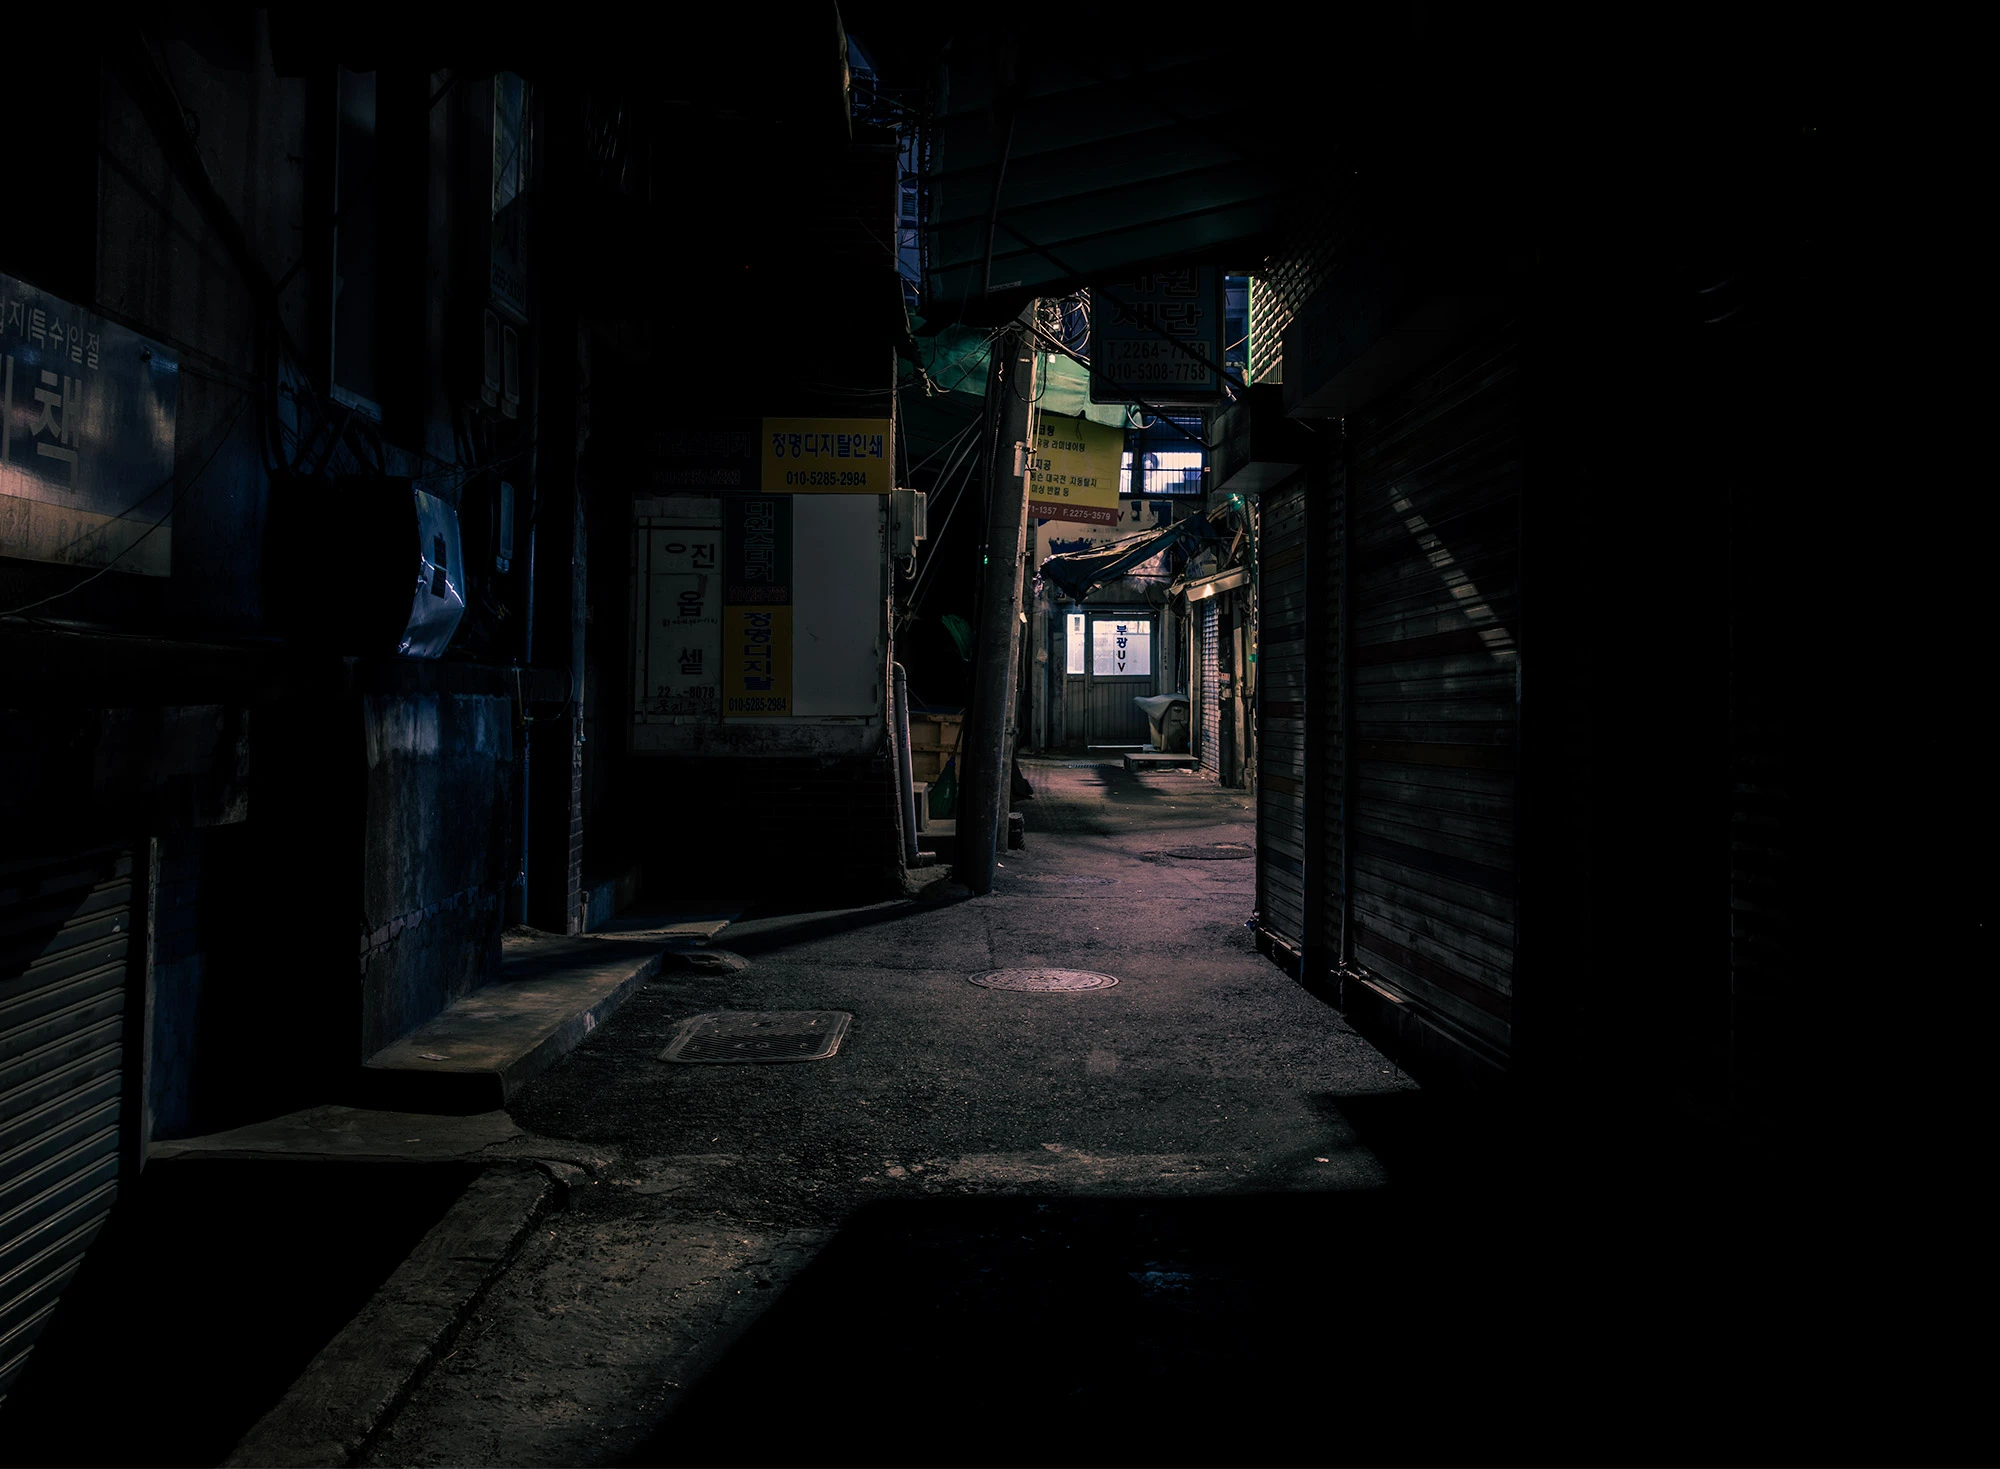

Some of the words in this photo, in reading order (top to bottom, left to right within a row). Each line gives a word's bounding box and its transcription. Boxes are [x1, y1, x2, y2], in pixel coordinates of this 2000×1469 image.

[1111, 301, 1205, 335] 재단
[1109, 362, 1206, 380] 010-5308-7758
[772, 433, 884, 458] 정명디지탈인쇄
[1051, 440, 1086, 452] 라미네이팅
[786, 471, 867, 486] 010-5285-2984
[1063, 510, 1111, 521] F.2275-3579
[743, 612, 775, 691] 정명디지탈
[1116, 624, 1128, 672] 부광UV
[728, 697, 786, 712] 010-5285-2984
